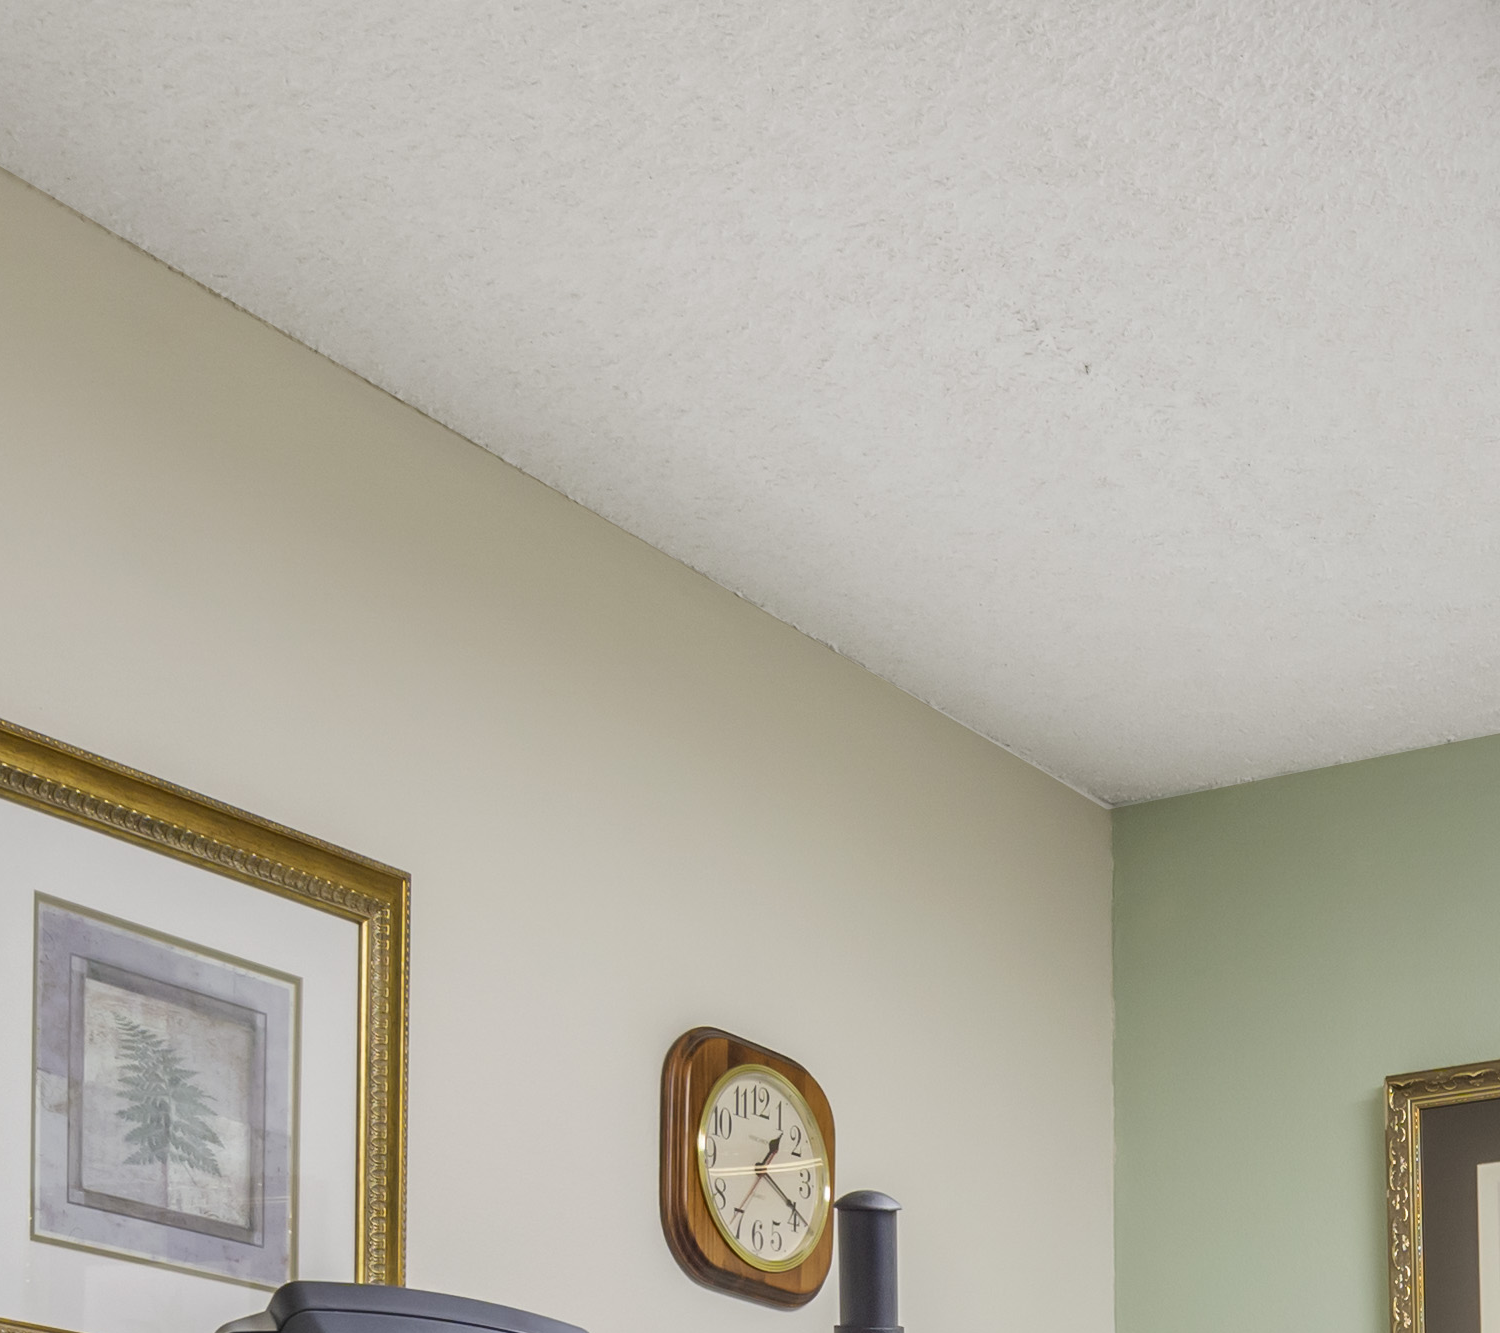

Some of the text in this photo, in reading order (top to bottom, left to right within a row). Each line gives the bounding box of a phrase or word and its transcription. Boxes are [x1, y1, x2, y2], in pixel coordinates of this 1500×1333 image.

[733, 1085, 749, 1120] 11
[751, 1085, 770, 1120] 12
[775, 1100, 784, 1131] 1
[712, 1105, 733, 1140] 10
[705, 1136, 717, 1169] 9
[790, 1125, 802, 1158] 2
[713, 1177, 727, 1210] 8
[798, 1169, 811, 1199] 3
[734, 1207, 745, 1240] 7
[787, 1202, 801, 1232] 4
[751, 1220, 764, 1252] 6
[770, 1220, 783, 1252] 5
